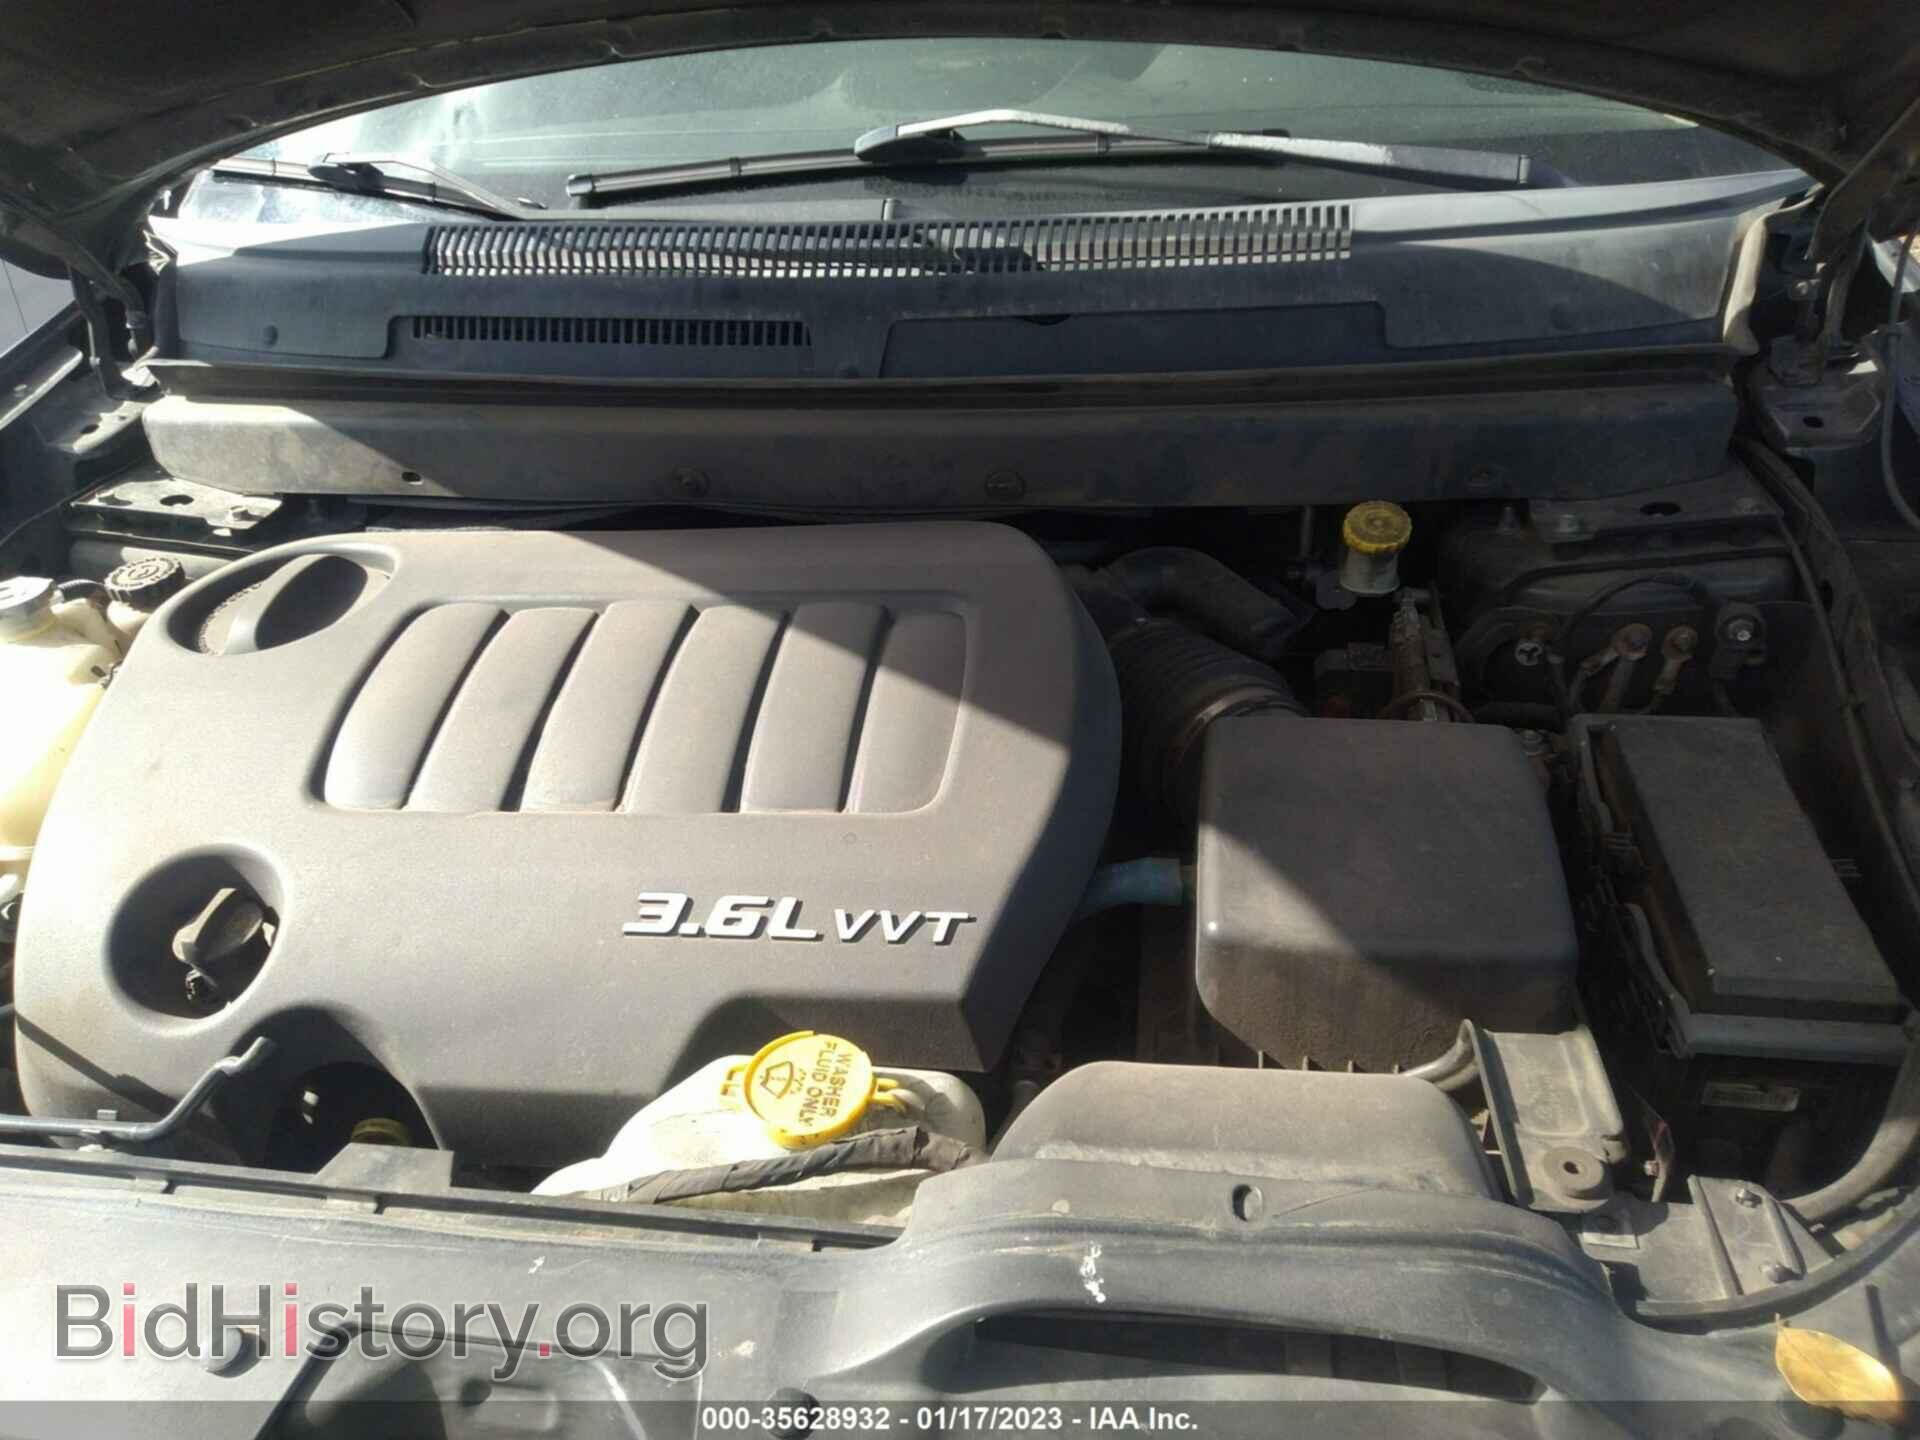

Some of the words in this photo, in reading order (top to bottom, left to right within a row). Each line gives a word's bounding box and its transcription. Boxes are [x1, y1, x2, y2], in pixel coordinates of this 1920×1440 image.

[623, 892, 822, 941] 3.6L
[834, 908, 975, 943] VVT
[810, 1041, 838, 1082] FLUID
[798, 1086, 823, 1127] ONLY
[818, 1052, 853, 1118] WASHER
